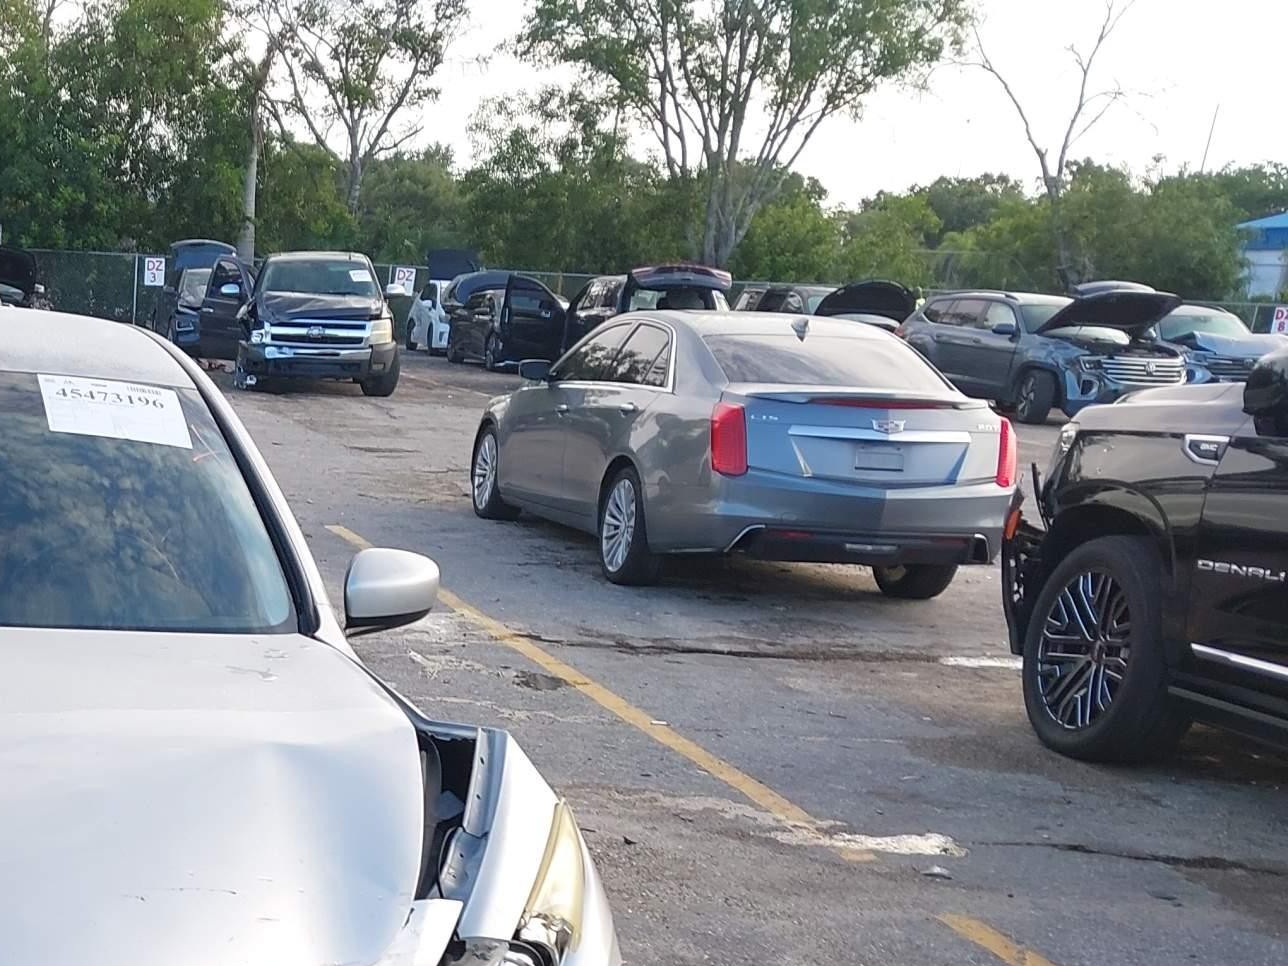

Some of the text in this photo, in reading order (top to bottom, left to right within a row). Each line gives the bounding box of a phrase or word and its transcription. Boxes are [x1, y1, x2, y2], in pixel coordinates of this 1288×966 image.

[147, 260, 163, 271] DZ
[150, 272, 156, 283] 3
[397, 270, 414, 281] DZ
[55, 387, 165, 409] 45473196
[1197, 559, 1286, 581] DENALI
